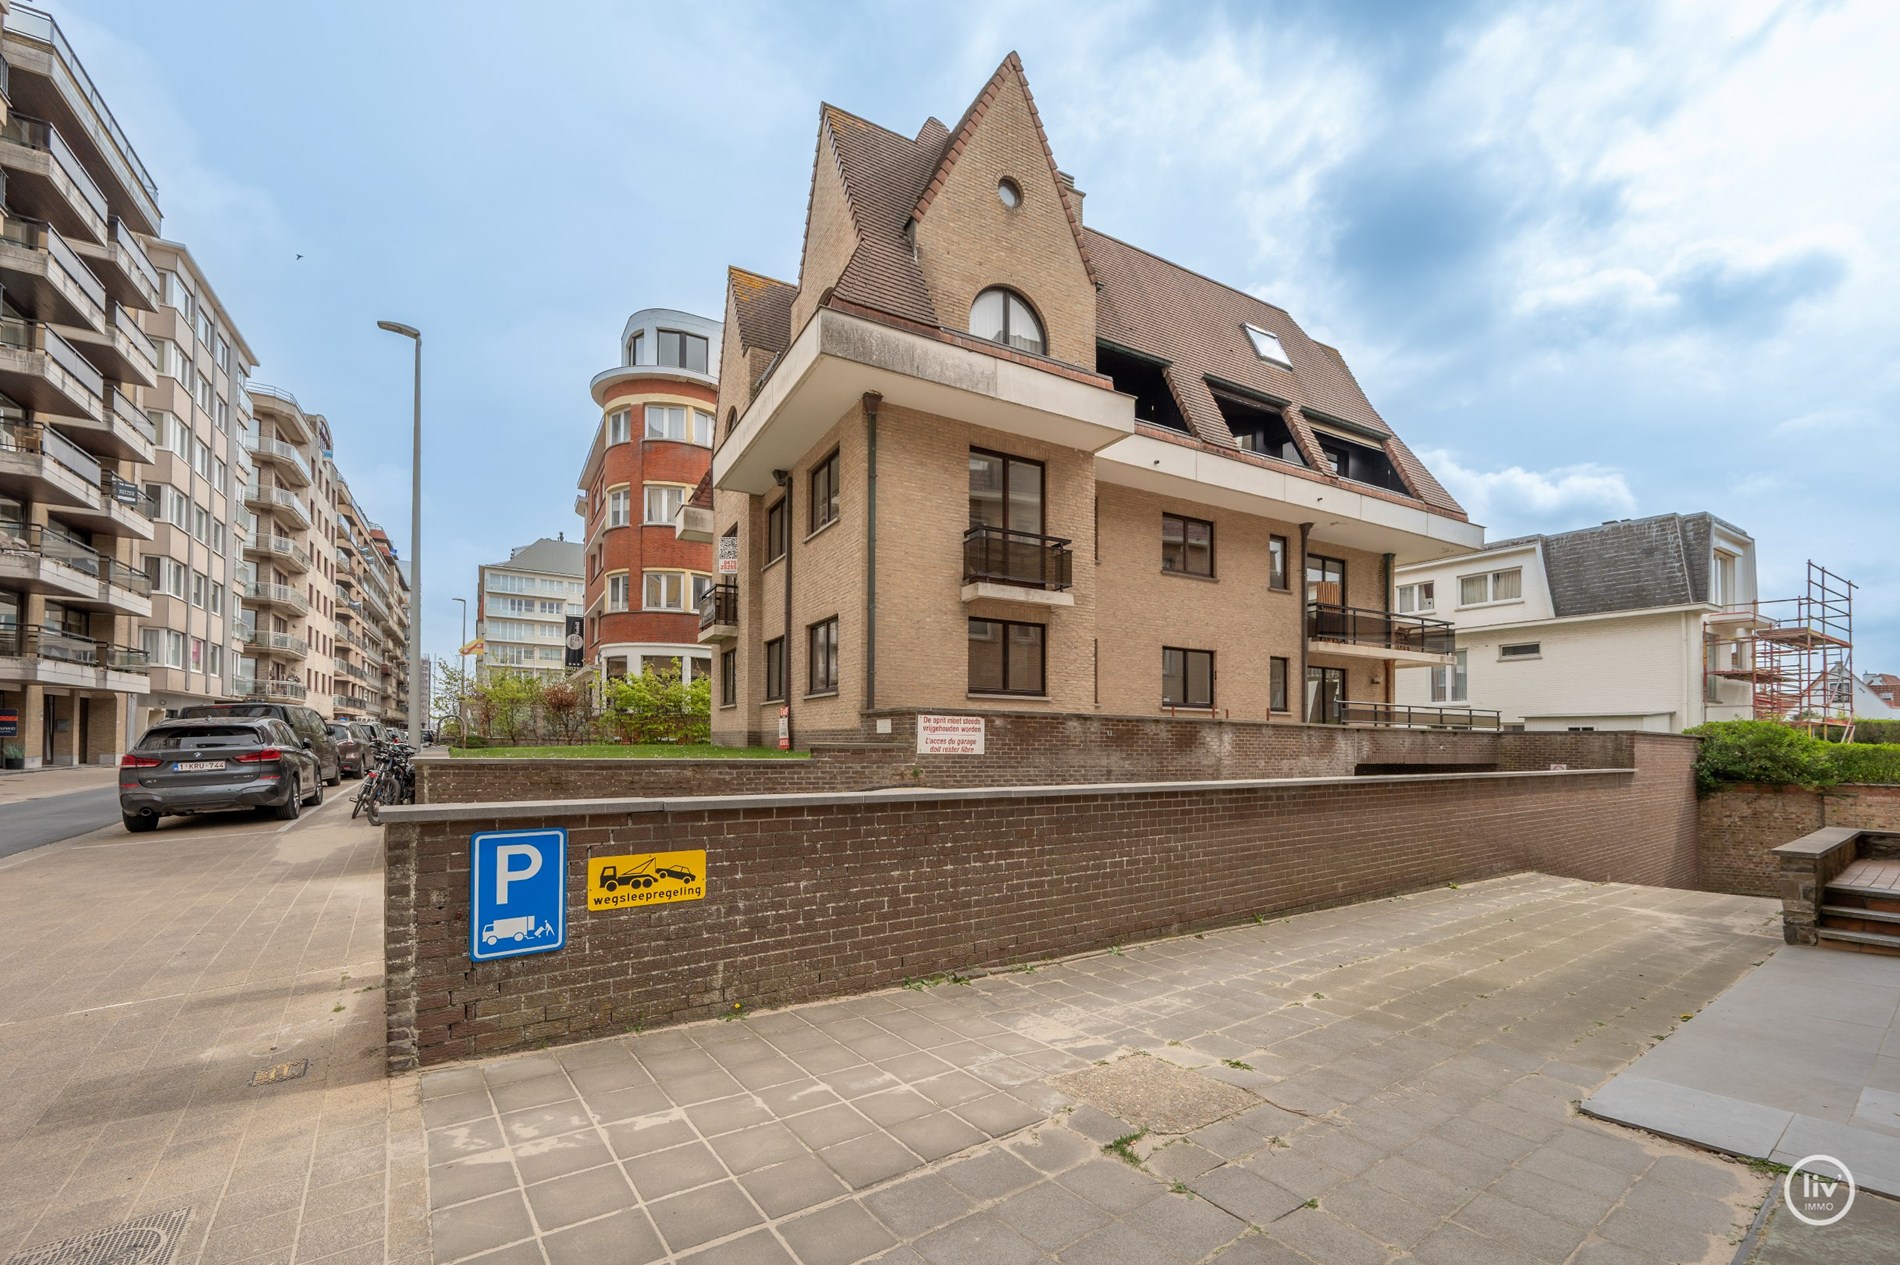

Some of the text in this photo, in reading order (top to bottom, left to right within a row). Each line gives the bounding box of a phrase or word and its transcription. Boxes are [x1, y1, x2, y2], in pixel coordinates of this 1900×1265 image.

[933, 716, 946, 724] oprit
[496, 844, 543, 905] P
[594, 886, 701, 906] wegsleepregeling
